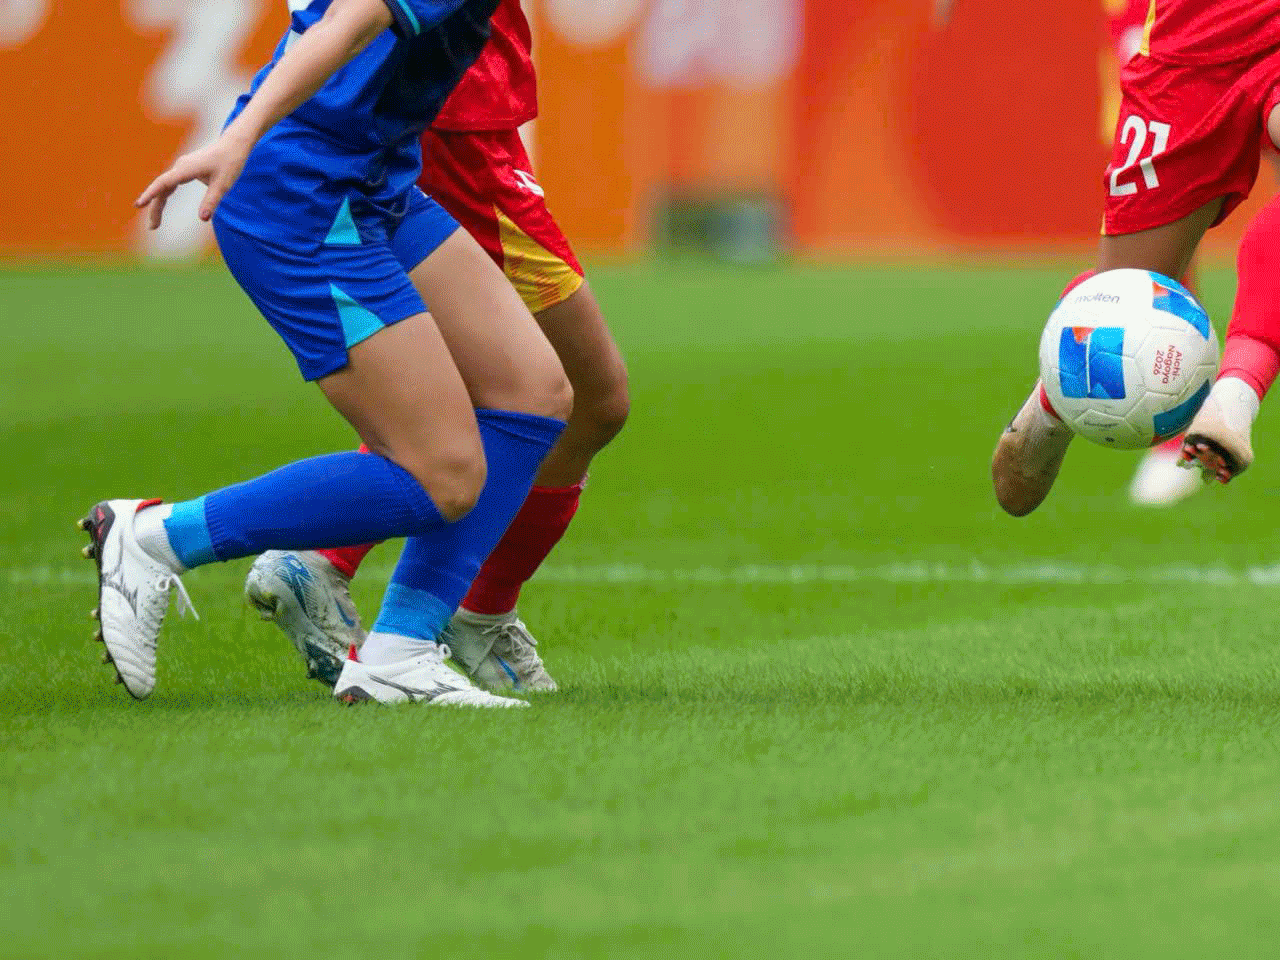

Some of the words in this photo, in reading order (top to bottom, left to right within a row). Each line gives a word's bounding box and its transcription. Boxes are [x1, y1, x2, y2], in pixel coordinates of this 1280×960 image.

[1109, 115, 1171, 196] 21
[1074, 292, 1120, 304] molten
[1153, 350, 1164, 375] 2026
[1162, 344, 1175, 384] Nagoya
